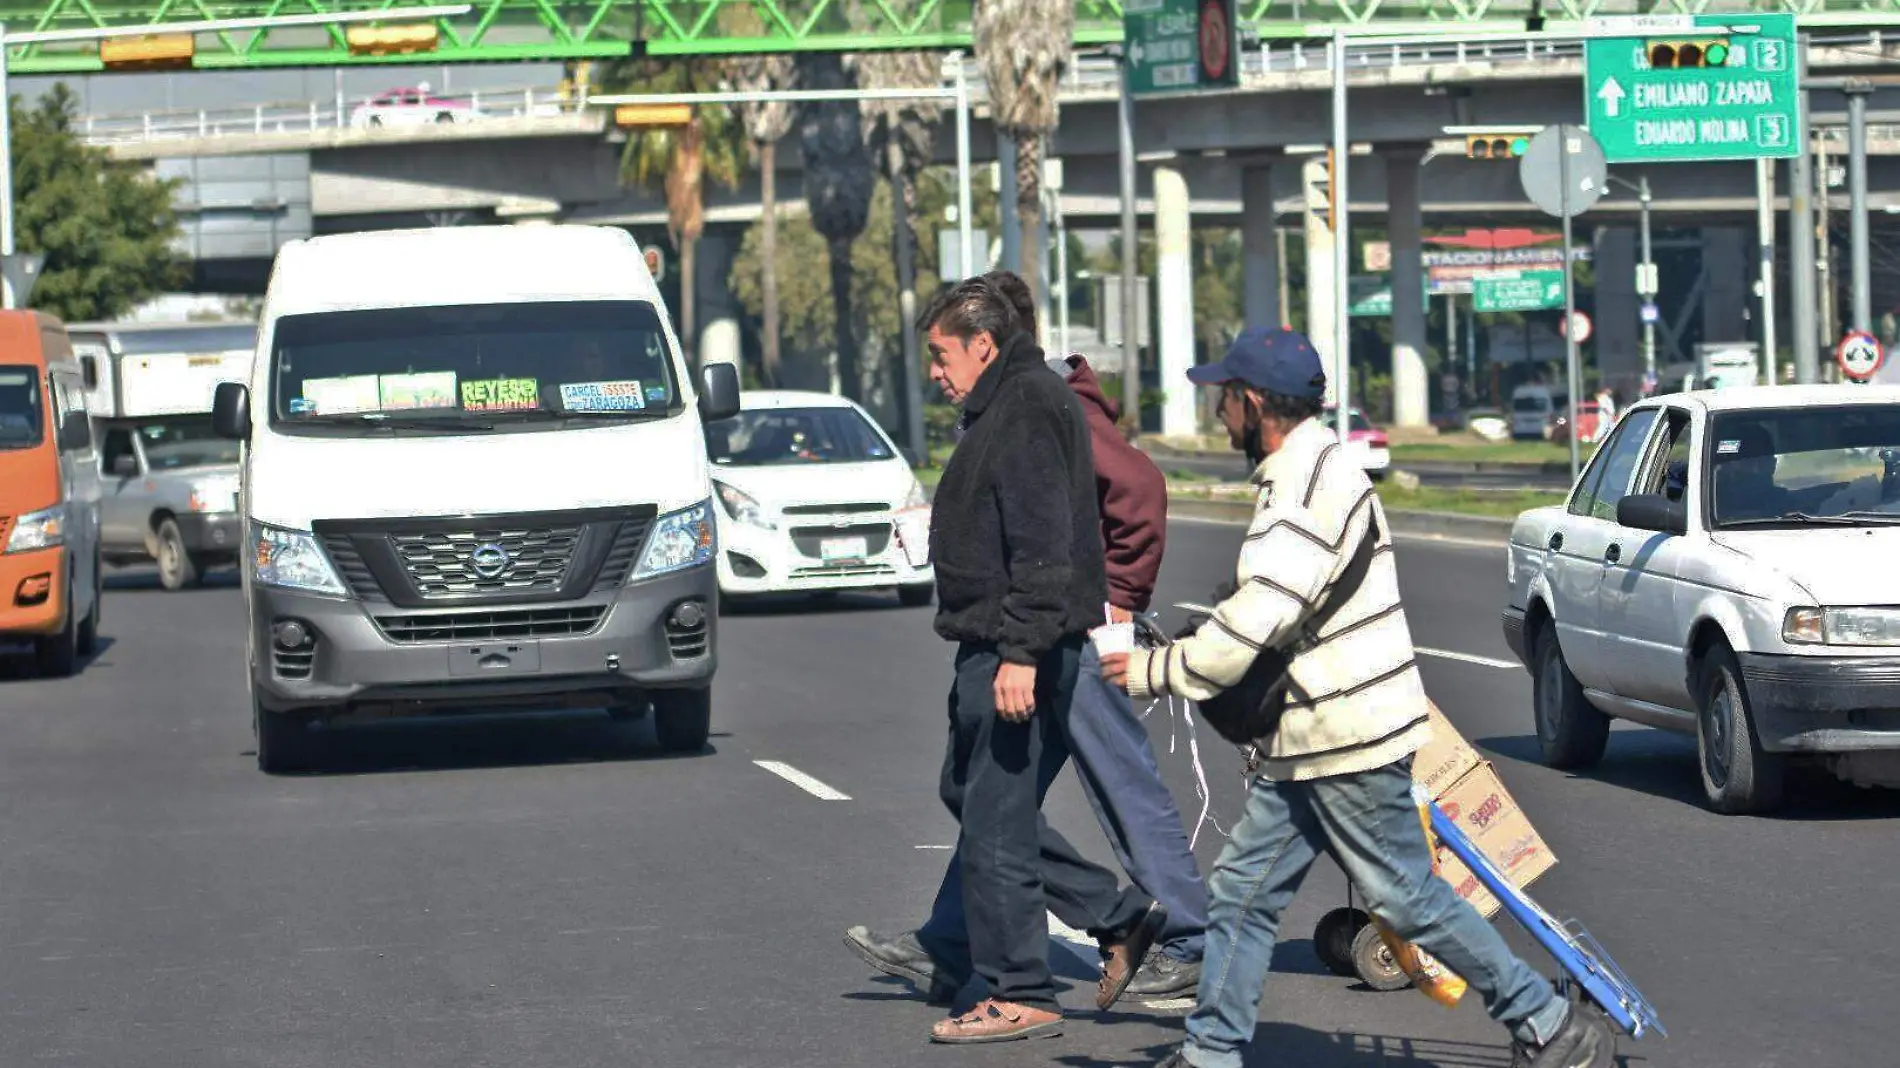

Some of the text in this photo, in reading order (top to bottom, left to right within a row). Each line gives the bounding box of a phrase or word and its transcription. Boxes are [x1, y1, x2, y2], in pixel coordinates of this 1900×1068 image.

[1763, 42, 1779, 69] 2
[1633, 79, 1773, 108] EMILIANO ZAPATA
[1634, 116, 1781, 145] EDUARDO MOLINA 3
[1421, 246, 1593, 267] STACIONAMIENTO
[462, 380, 518, 402] REYES
[564, 385, 602, 398] CARCEL
